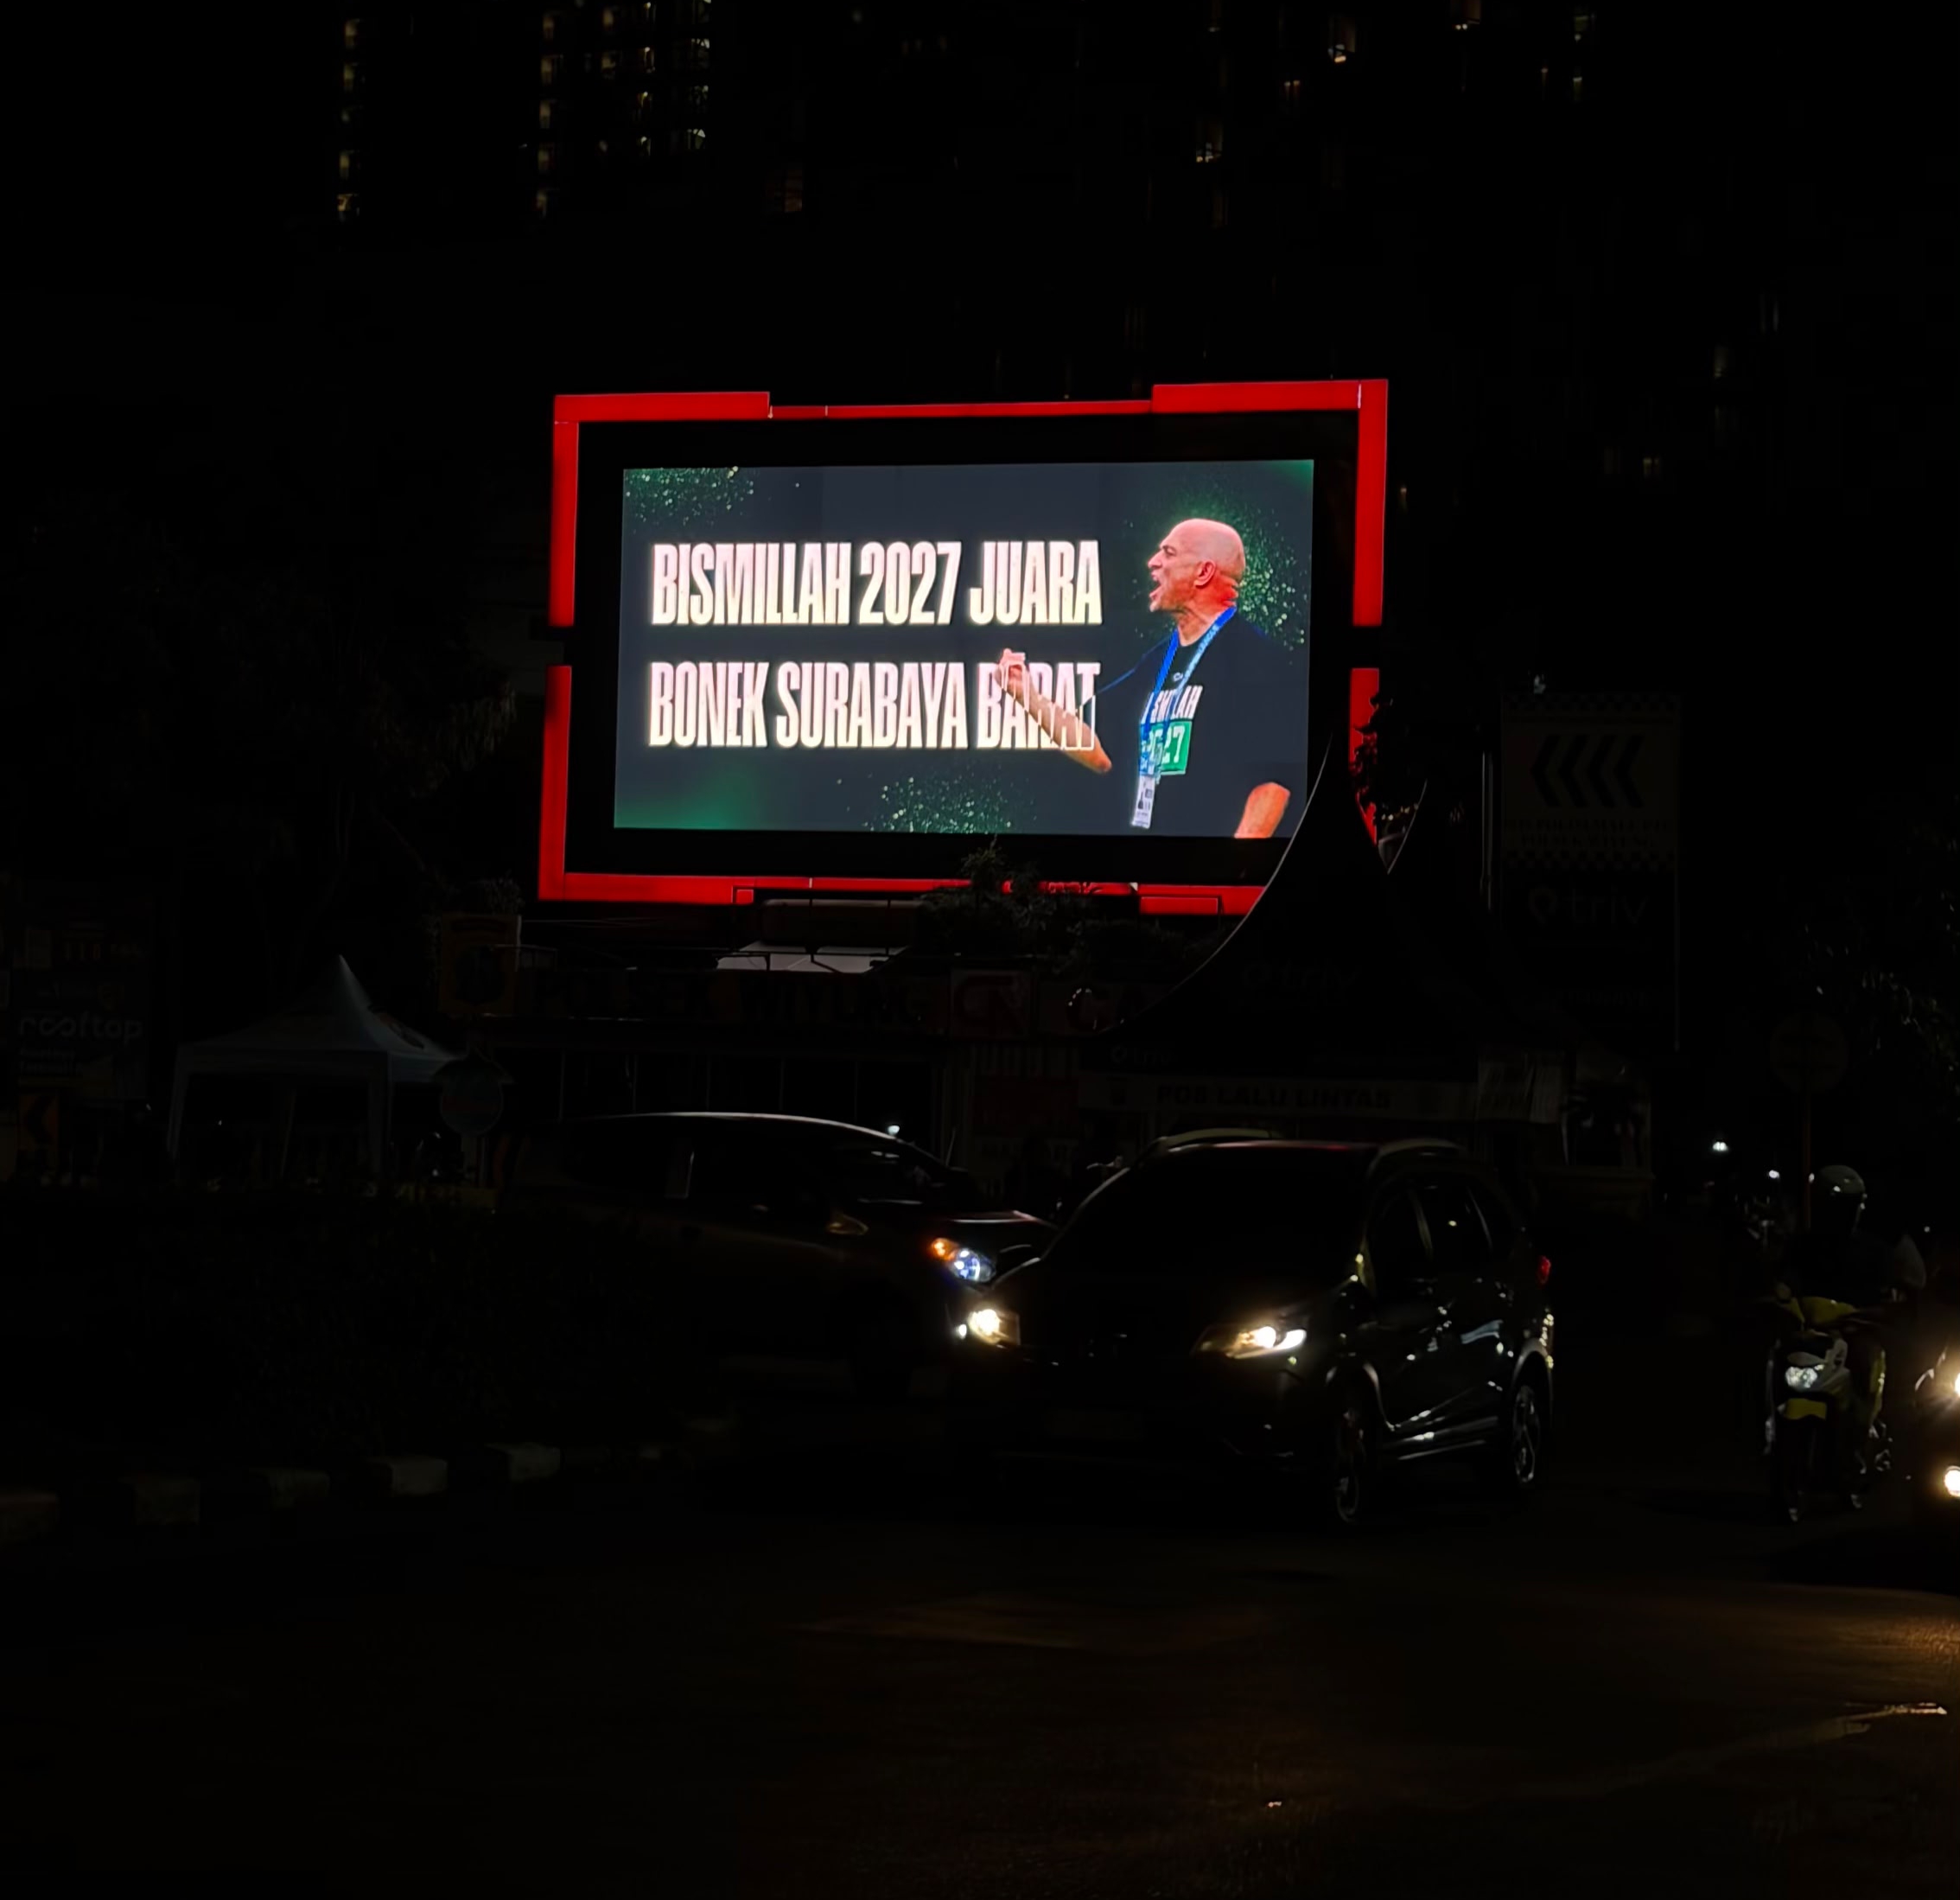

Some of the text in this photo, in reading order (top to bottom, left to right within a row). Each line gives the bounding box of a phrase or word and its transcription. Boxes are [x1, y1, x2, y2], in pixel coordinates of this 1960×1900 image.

[652, 539, 1104, 626] BISMILLAH 2027 JUARA
[648, 660, 771, 748] BONEK
[776, 660, 969, 749] SURABAYA
[1562, 883, 1651, 927] triv
[17, 1010, 143, 1047] rooftop
